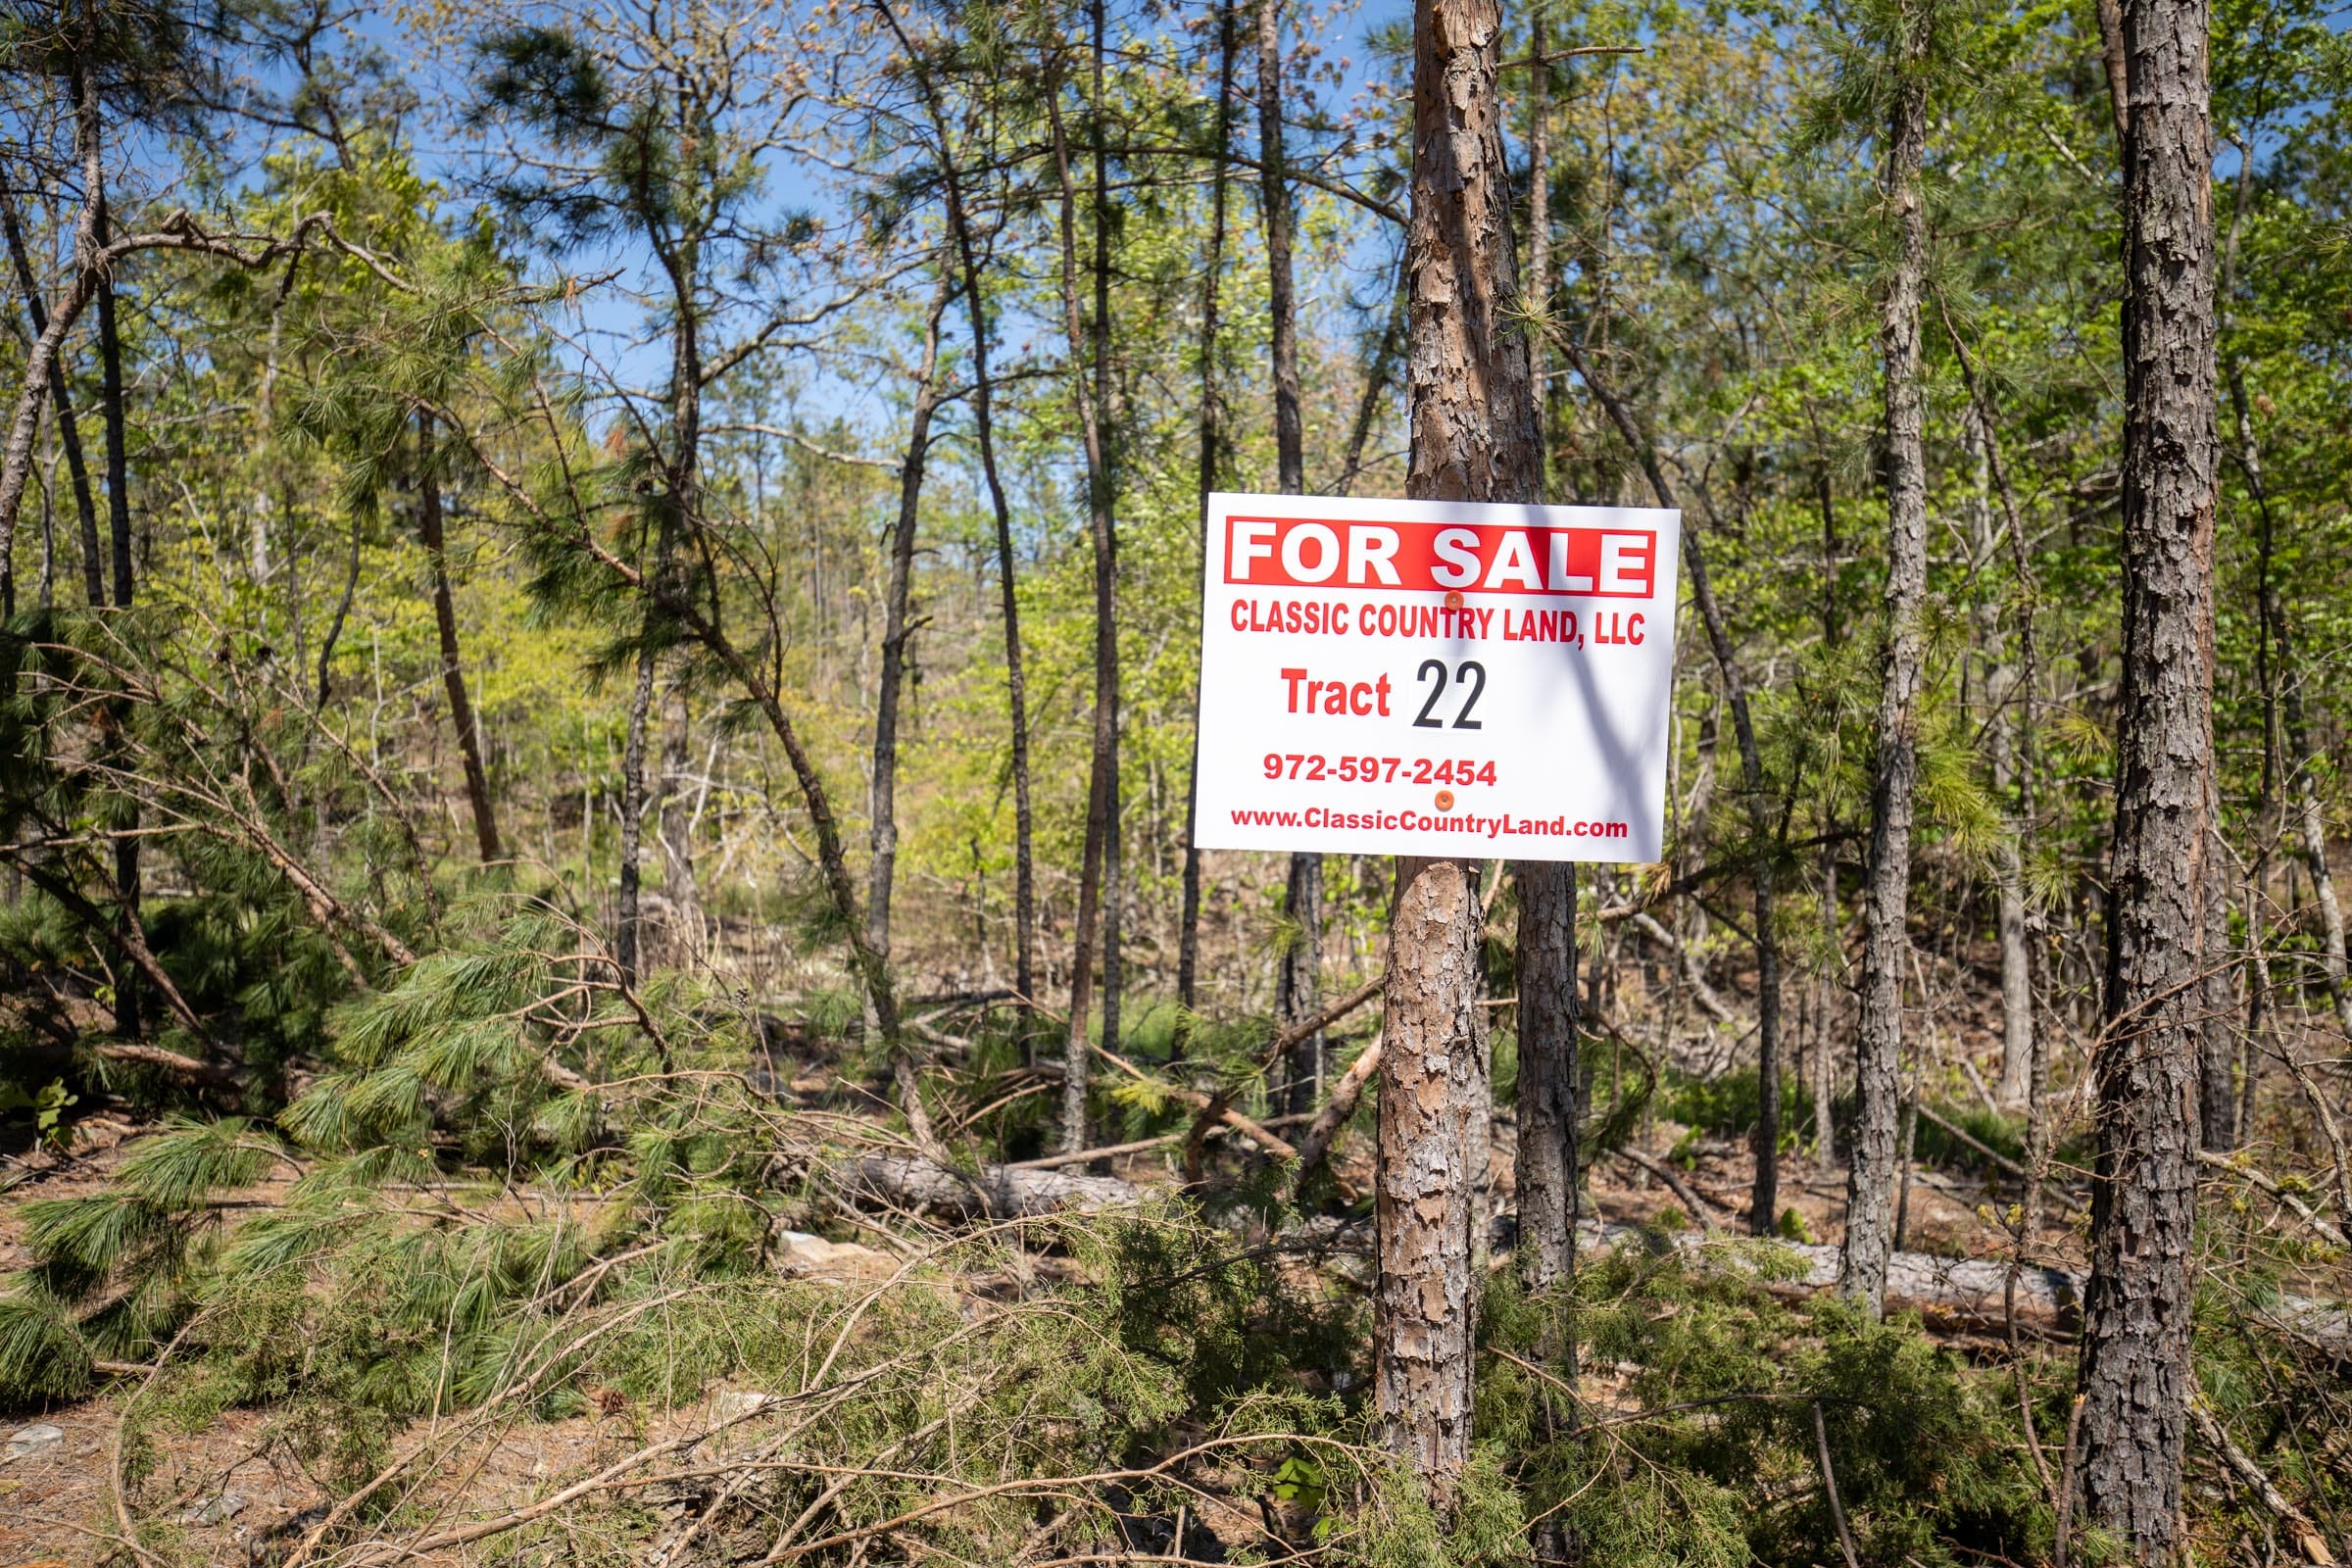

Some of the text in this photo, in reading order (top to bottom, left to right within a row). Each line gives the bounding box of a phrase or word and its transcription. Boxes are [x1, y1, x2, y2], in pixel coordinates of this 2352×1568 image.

[1230, 520, 1649, 595] FOR SALE
[1231, 599, 1645, 651] CLASSIC COUNTRY LAND, LLC
[1281, 659, 1487, 730] Tract 22
[1263, 753, 1497, 787] 972-597-2454
[1231, 807, 1629, 839] www.ClassicCountryLand.com
